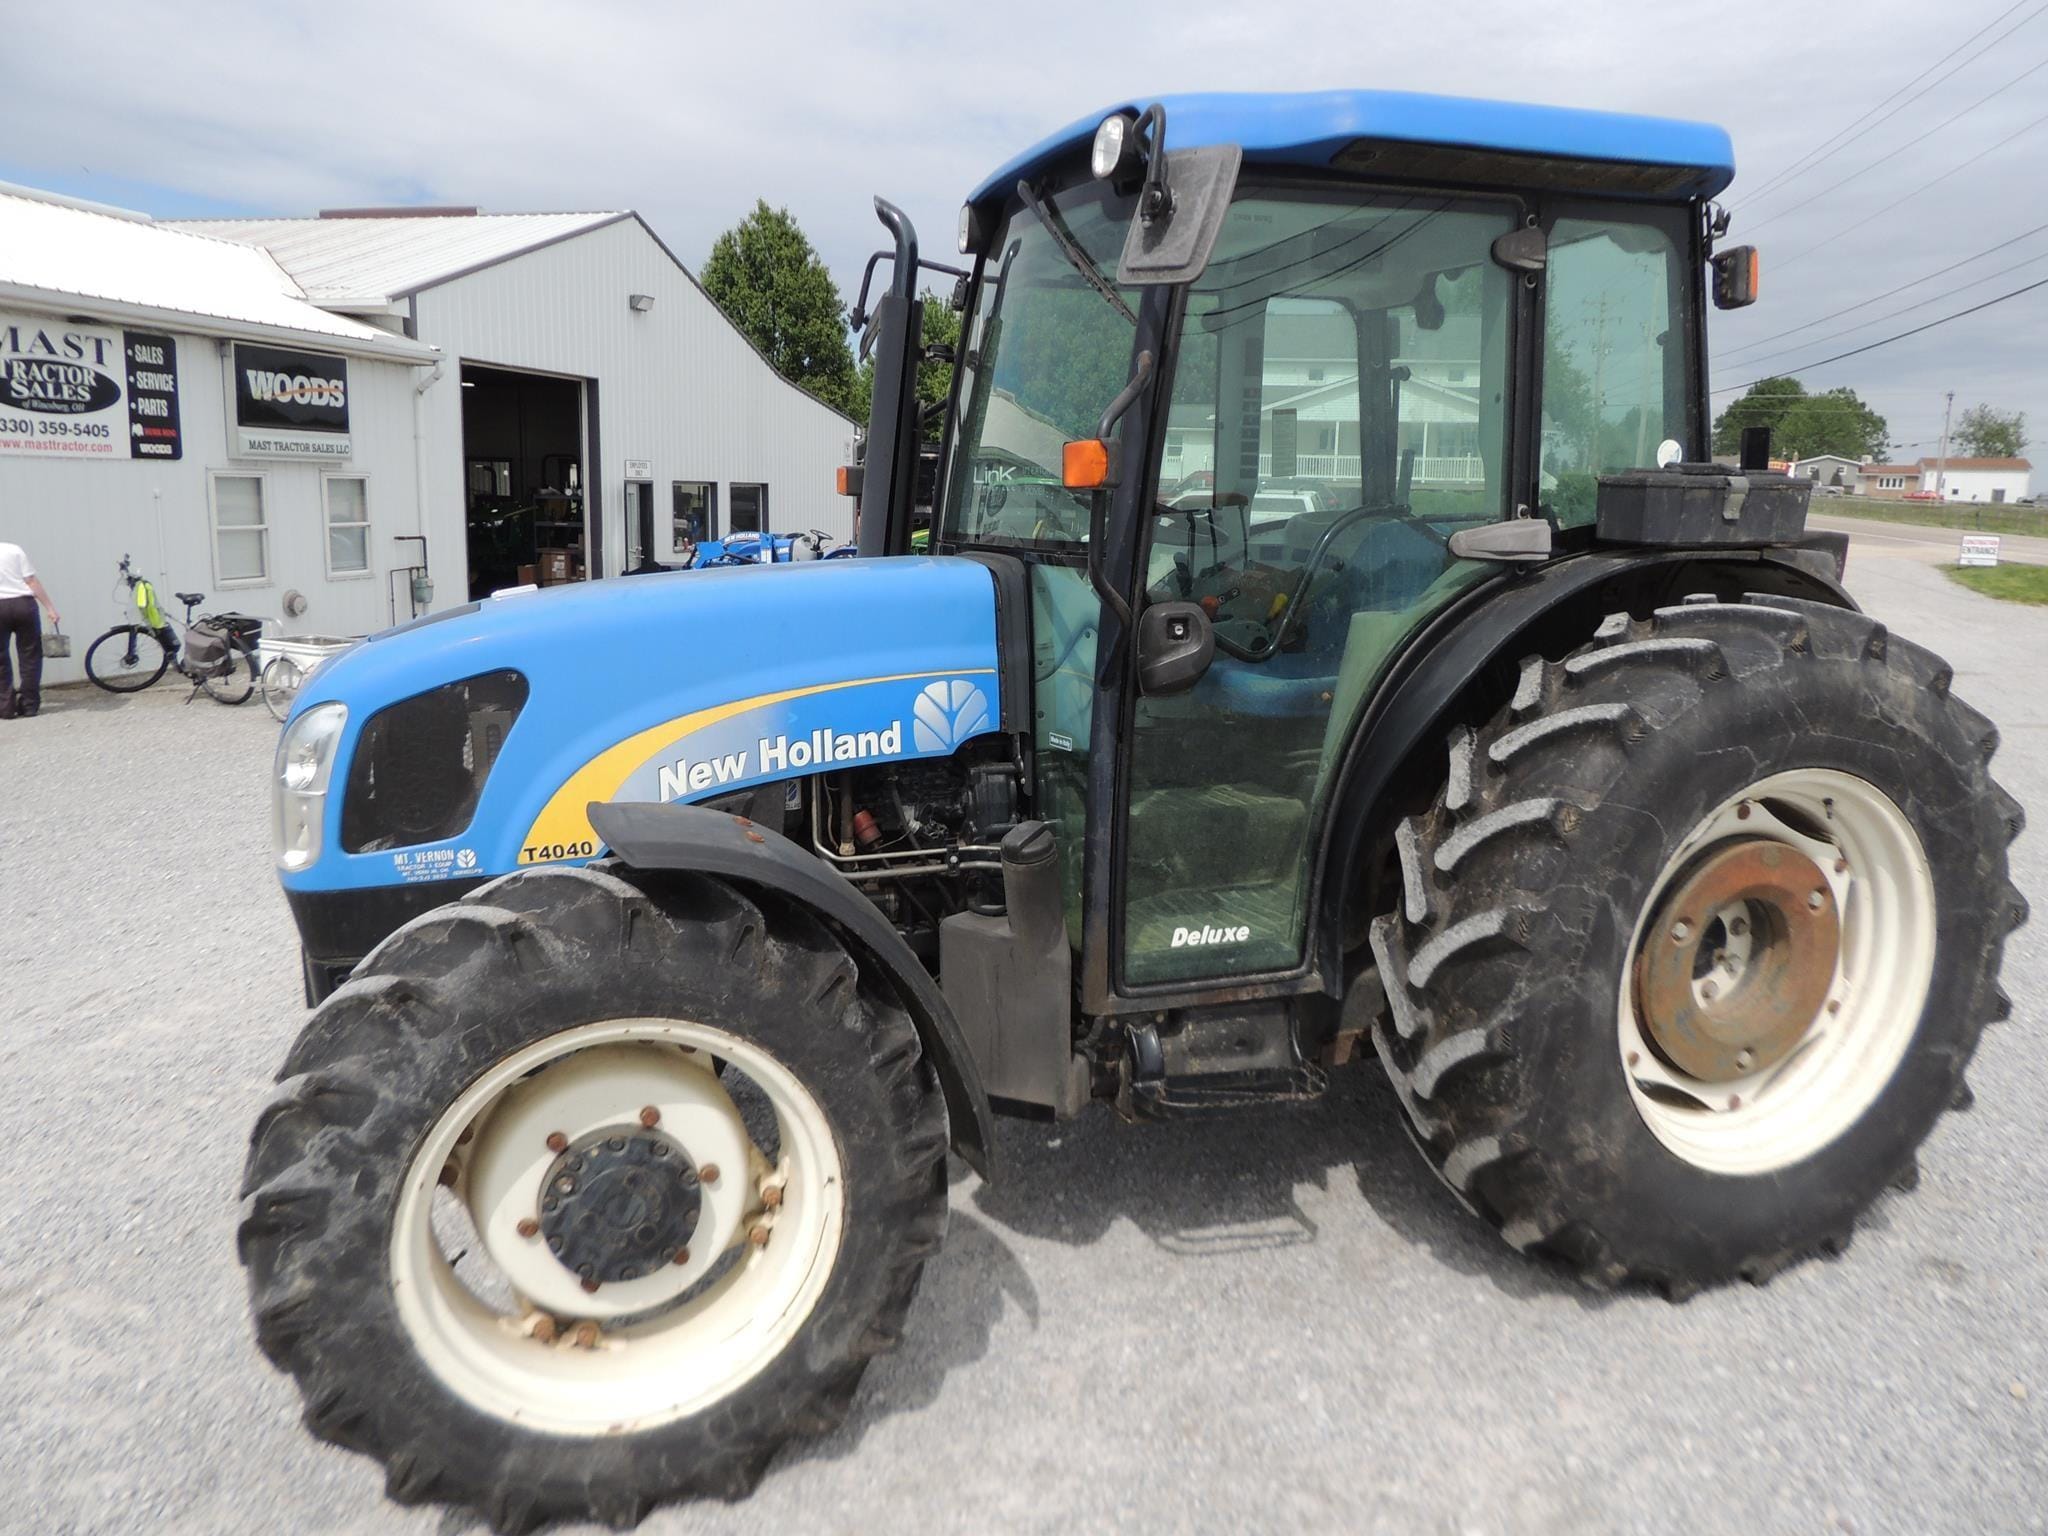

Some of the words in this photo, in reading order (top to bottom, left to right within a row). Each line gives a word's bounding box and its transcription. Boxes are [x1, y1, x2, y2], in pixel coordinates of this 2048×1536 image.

[134, 344, 164, 365] SALES
[10, 378, 92, 402] SALES
[136, 371, 175, 393] SERVICE
[246, 369, 345, 408] WOODS
[137, 398, 169, 418] PARTS
[39, 421, 110, 438] 359-5405
[248, 440, 273, 451] MAST
[273, 442, 311, 453] TRACTOR
[312, 443, 335, 454] SALES
[336, 445, 350, 455] LLC
[657, 750, 747, 802] New
[759, 720, 901, 773] Holland
[393, 853, 412, 865] MT.
[415, 849, 454, 863] VERNON
[524, 840, 594, 862] T4040
[1170, 924, 1251, 948] Deluxe
